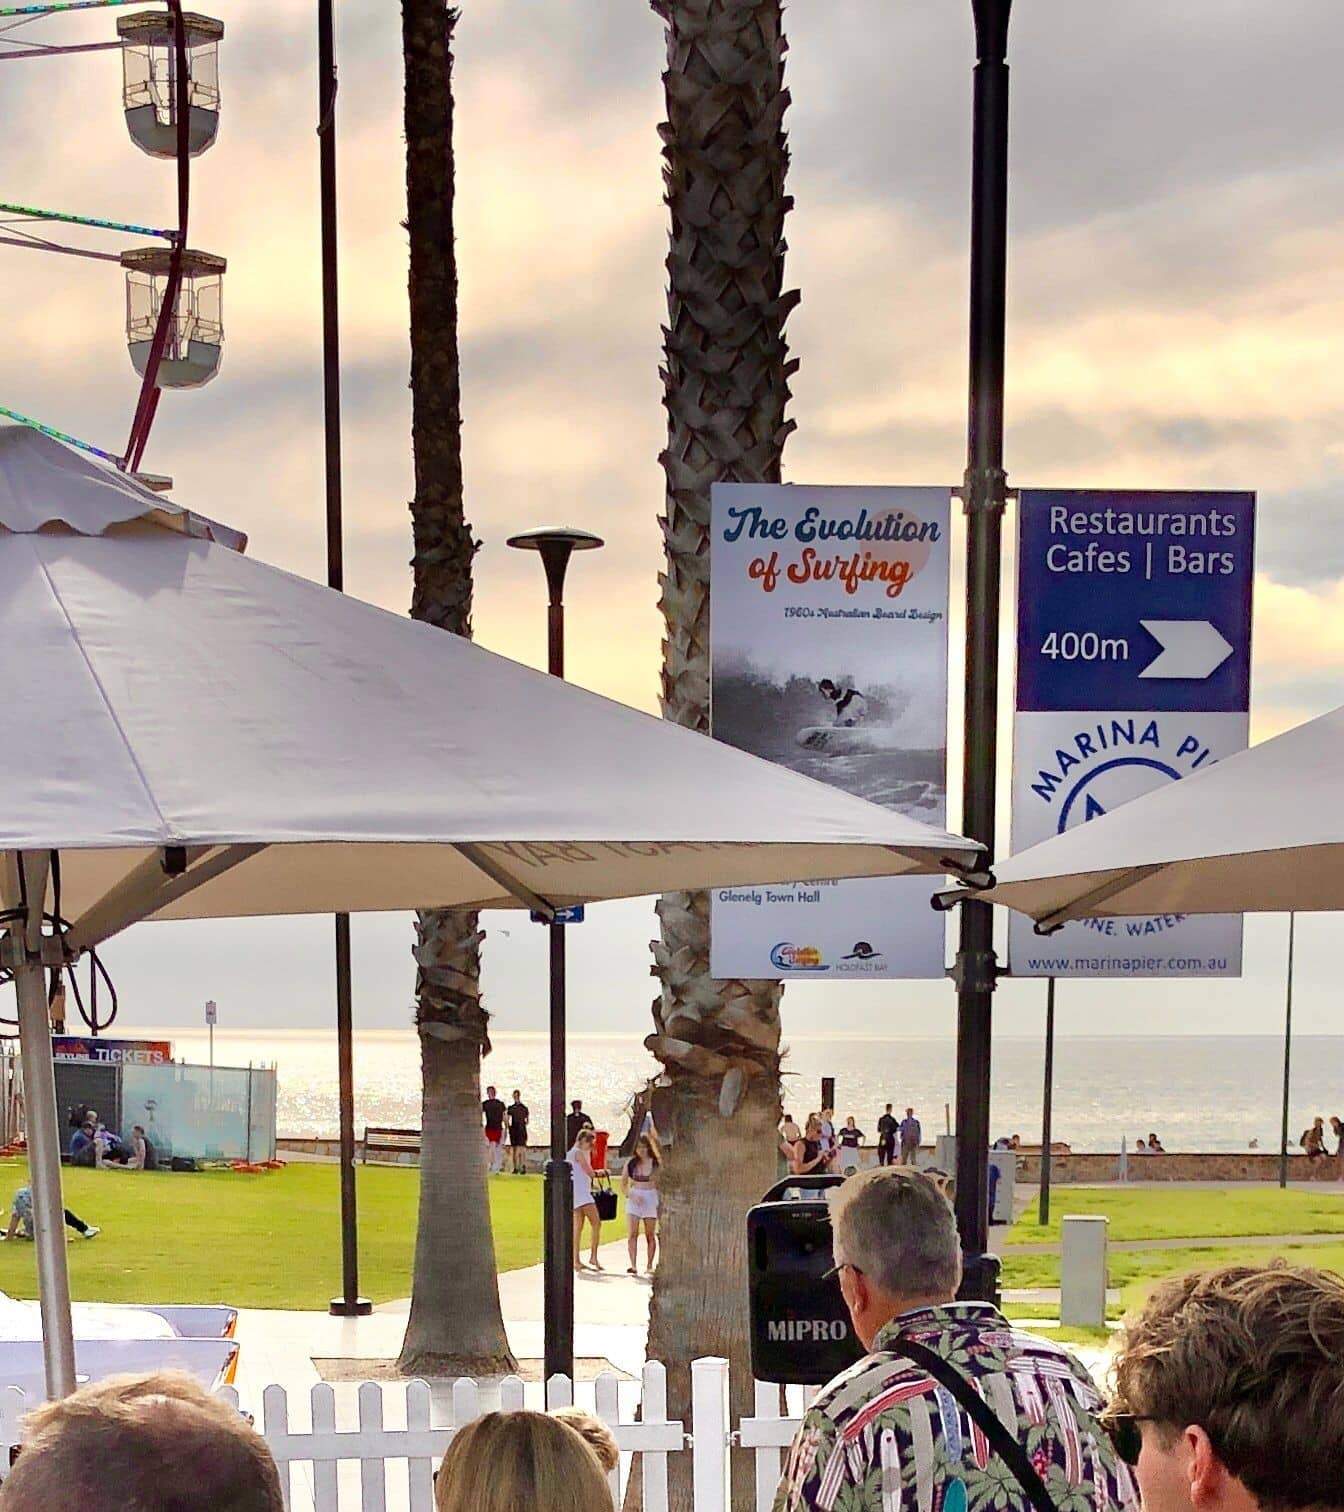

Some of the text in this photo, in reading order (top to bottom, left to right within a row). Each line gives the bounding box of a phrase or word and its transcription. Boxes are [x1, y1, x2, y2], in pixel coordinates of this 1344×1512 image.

[723, 507, 941, 543] The Evolution
[1050, 506, 1237, 536] Restaurants
[748, 547, 914, 598] of Surfing
[1047, 542, 1132, 573] Cafes
[1168, 545, 1235, 575] Bars
[1040, 632, 1129, 661] 400m
[1031, 719, 1161, 803] MARINA
[719, 890, 821, 906] Glenelg Town Hall
[1028, 955, 1228, 973] www.marinapier.com.au
[95, 1048, 165, 1064] TICKETS
[767, 1319, 848, 1342] MIPRO
